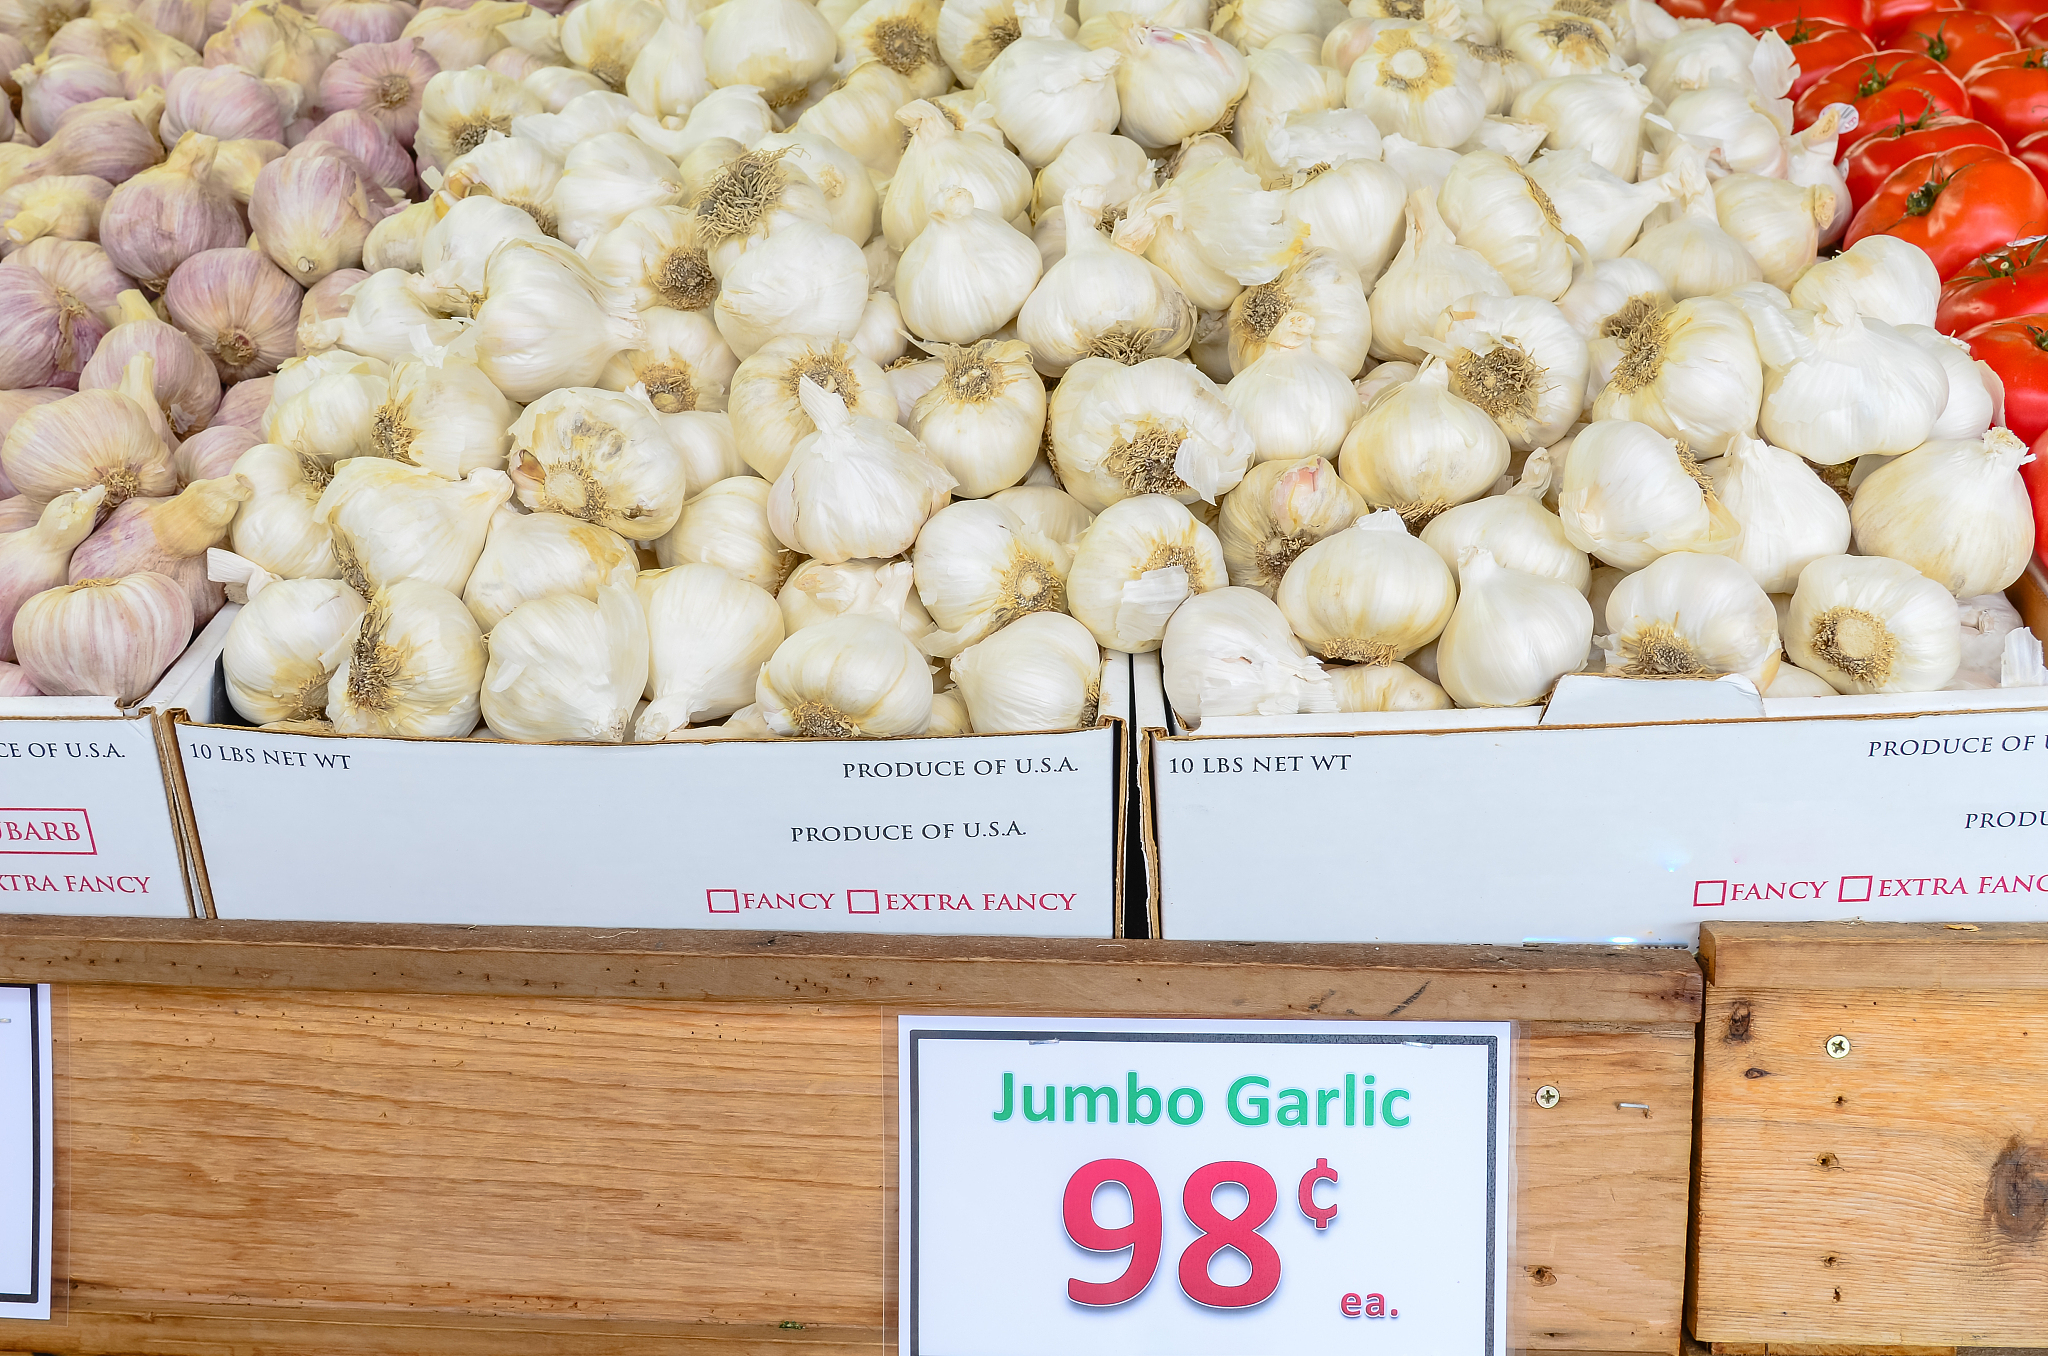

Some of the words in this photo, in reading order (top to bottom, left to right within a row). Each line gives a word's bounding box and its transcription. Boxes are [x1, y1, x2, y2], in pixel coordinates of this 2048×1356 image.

[27, 742, 57, 758] OF
[64, 742, 126, 758] U.S.A.
[189, 743, 212, 760] 10
[217, 745, 256, 764] LBS
[262, 749, 308, 768] NET
[312, 752, 352, 771] WT
[1867, 736, 1994, 758] PRODUCE
[2001, 734, 2036, 752] OF
[842, 760, 966, 779] PRODUCE
[973, 759, 1007, 776] OF
[1014, 756, 1079, 774] U.S.A.
[1169, 757, 1194, 774] 10
[1202, 756, 1243, 774] LBS
[1252, 755, 1304, 773] NET
[1309, 754, 1352, 772] WT
[0, 821, 81, 841] BARB
[790, 824, 914, 843] PRODUCE
[921, 823, 955, 840] OF
[962, 820, 1027, 838] U.S.A.
[63, 875, 151, 894] FANCY
[1730, 880, 1829, 901] FANCY
[1877, 876, 1969, 898] EXTRA
[741, 892, 836, 910] FANCY
[884, 893, 975, 911] EXTRA
[981, 893, 1077, 911] FANCY
[992, 1069, 1204, 1126] Jumbo
[1225, 1074, 1411, 1128] Garlic
[1340, 1292, 1399, 1320] ea.
